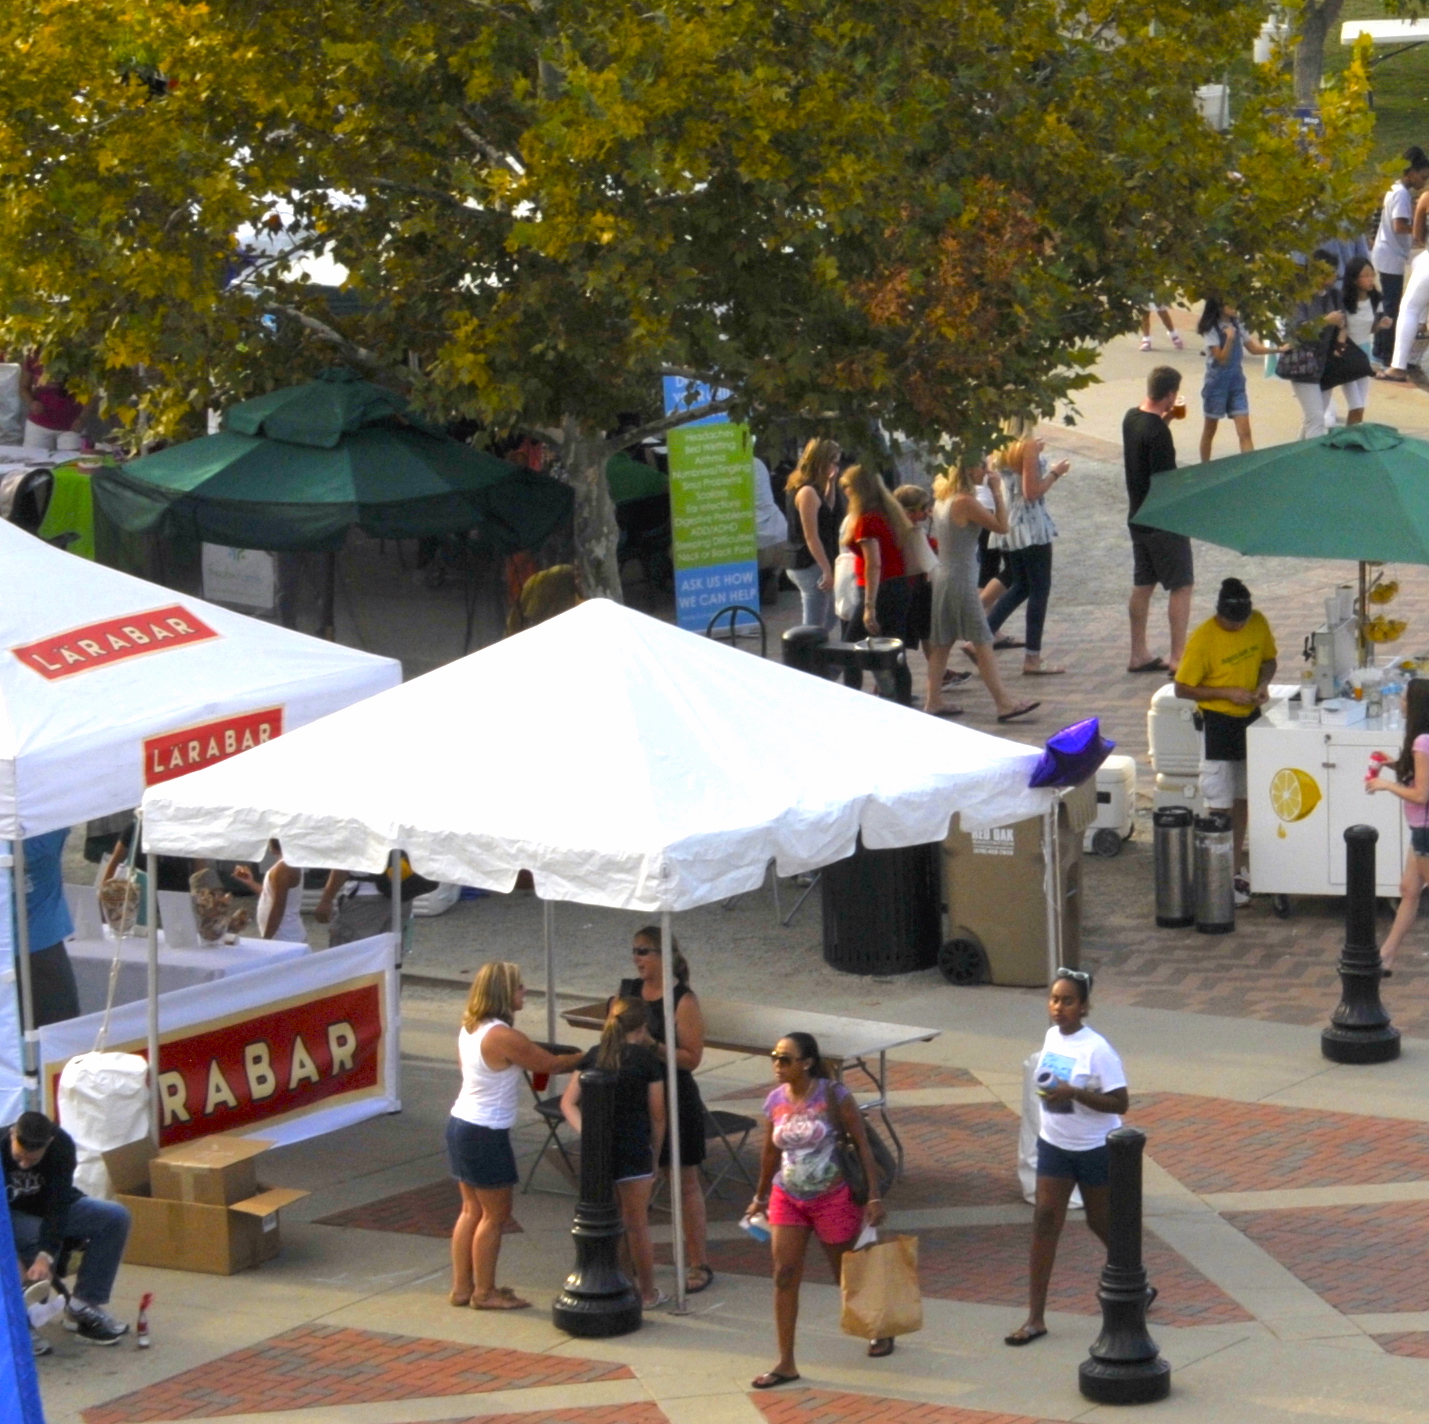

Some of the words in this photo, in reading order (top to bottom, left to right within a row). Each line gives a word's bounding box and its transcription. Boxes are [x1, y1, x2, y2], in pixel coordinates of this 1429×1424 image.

[679, 595, 697, 609] WE
[699, 591, 727, 606] CAN
[729, 587, 757, 603] HELP
[681, 577, 703, 593] ASK
[706, 575, 721, 589] US
[723, 571, 754, 587] HOW
[31, 617, 196, 672] LÄRABAR
[152, 721, 272, 774] LÄRABAR
[157, 1020, 358, 1127] RABAR
